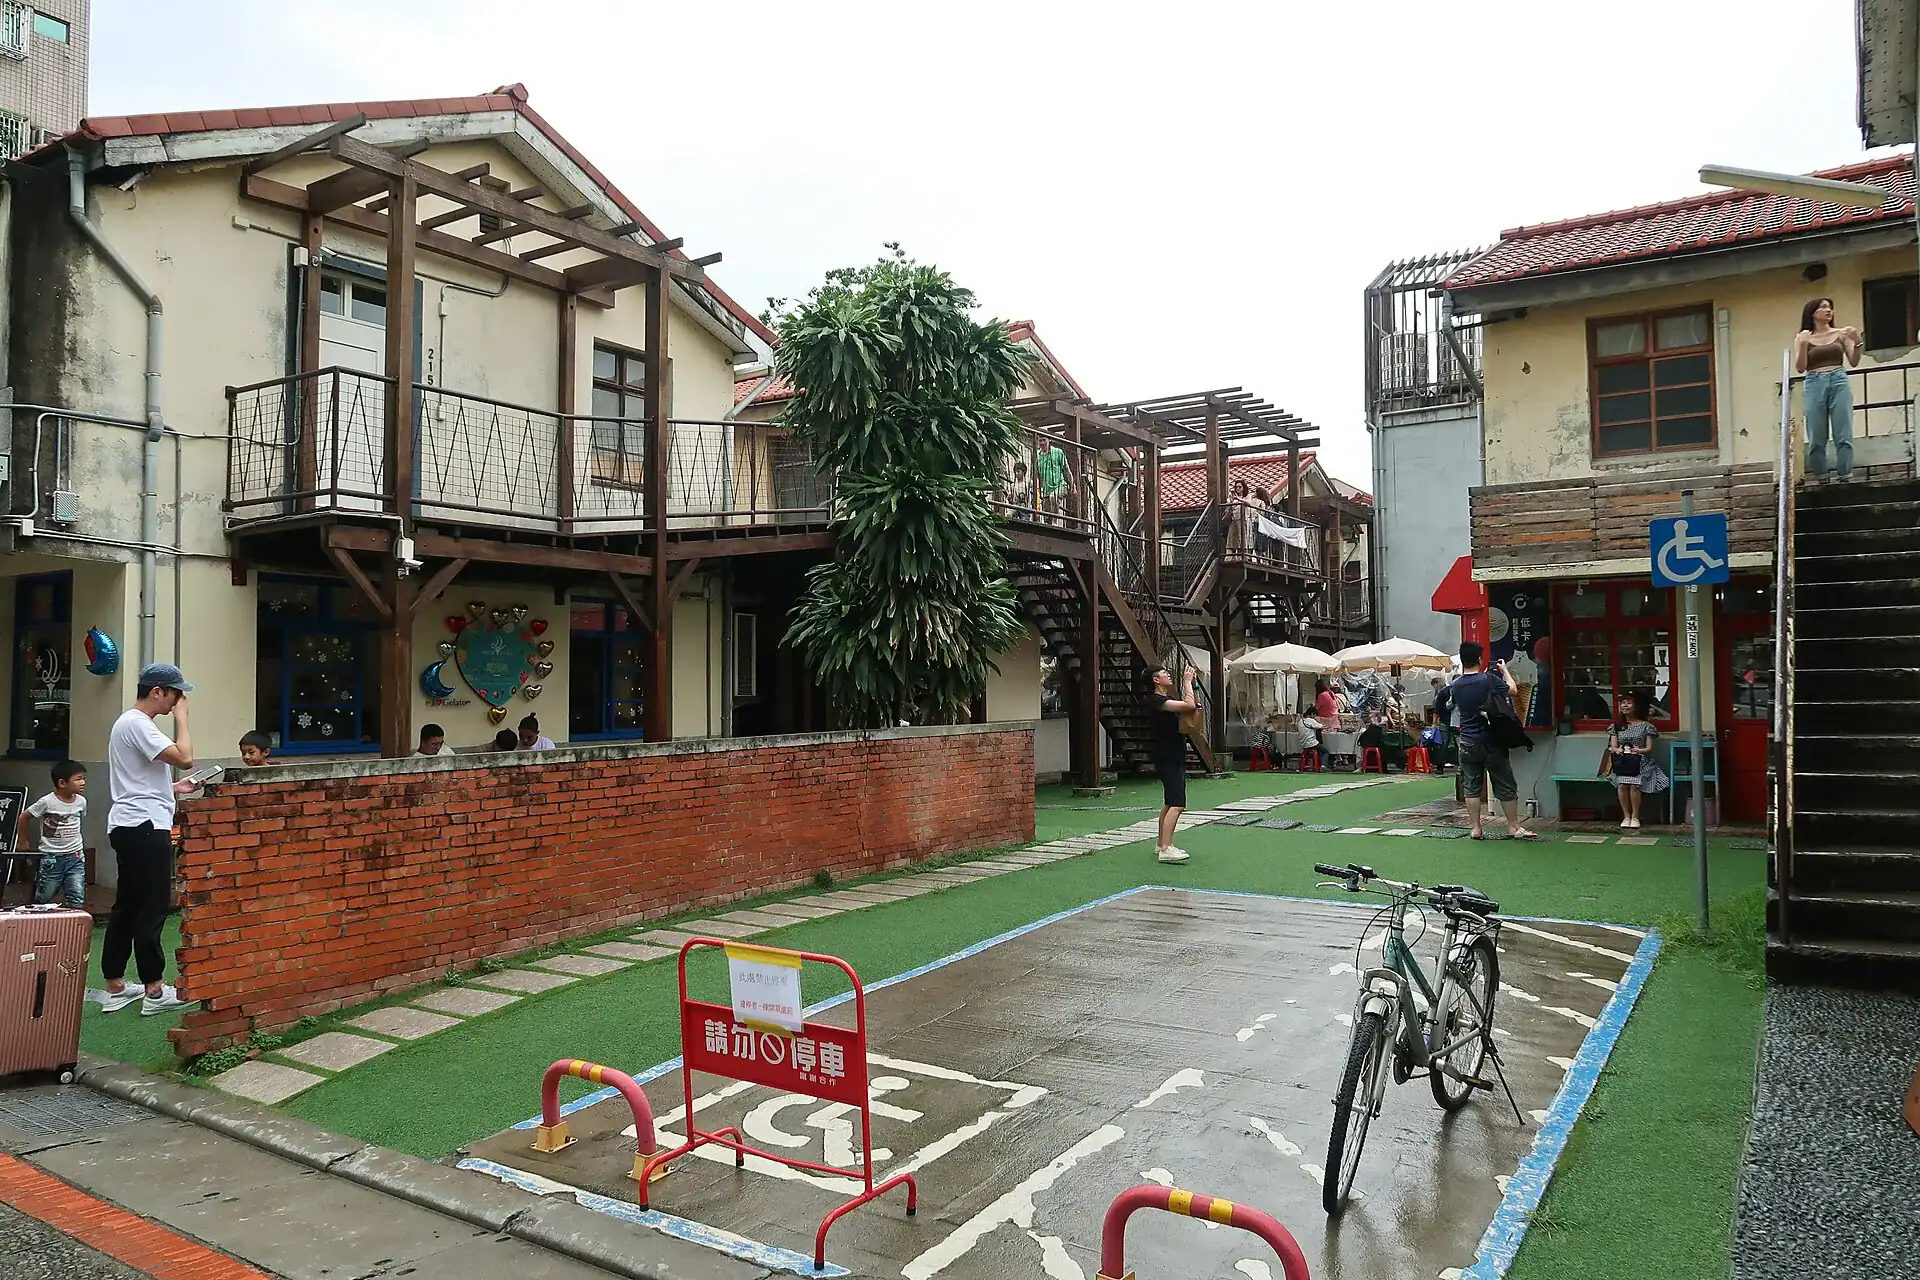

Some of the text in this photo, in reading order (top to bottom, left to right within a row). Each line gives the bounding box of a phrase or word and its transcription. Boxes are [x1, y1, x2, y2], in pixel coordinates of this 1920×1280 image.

[1520, 616, 1531, 641] 低卡
[442, 698, 468, 707] Gelato
[705, 1019, 844, 1078] 請勿 停車
[799, 1071, 837, 1086] 謝謝合作
